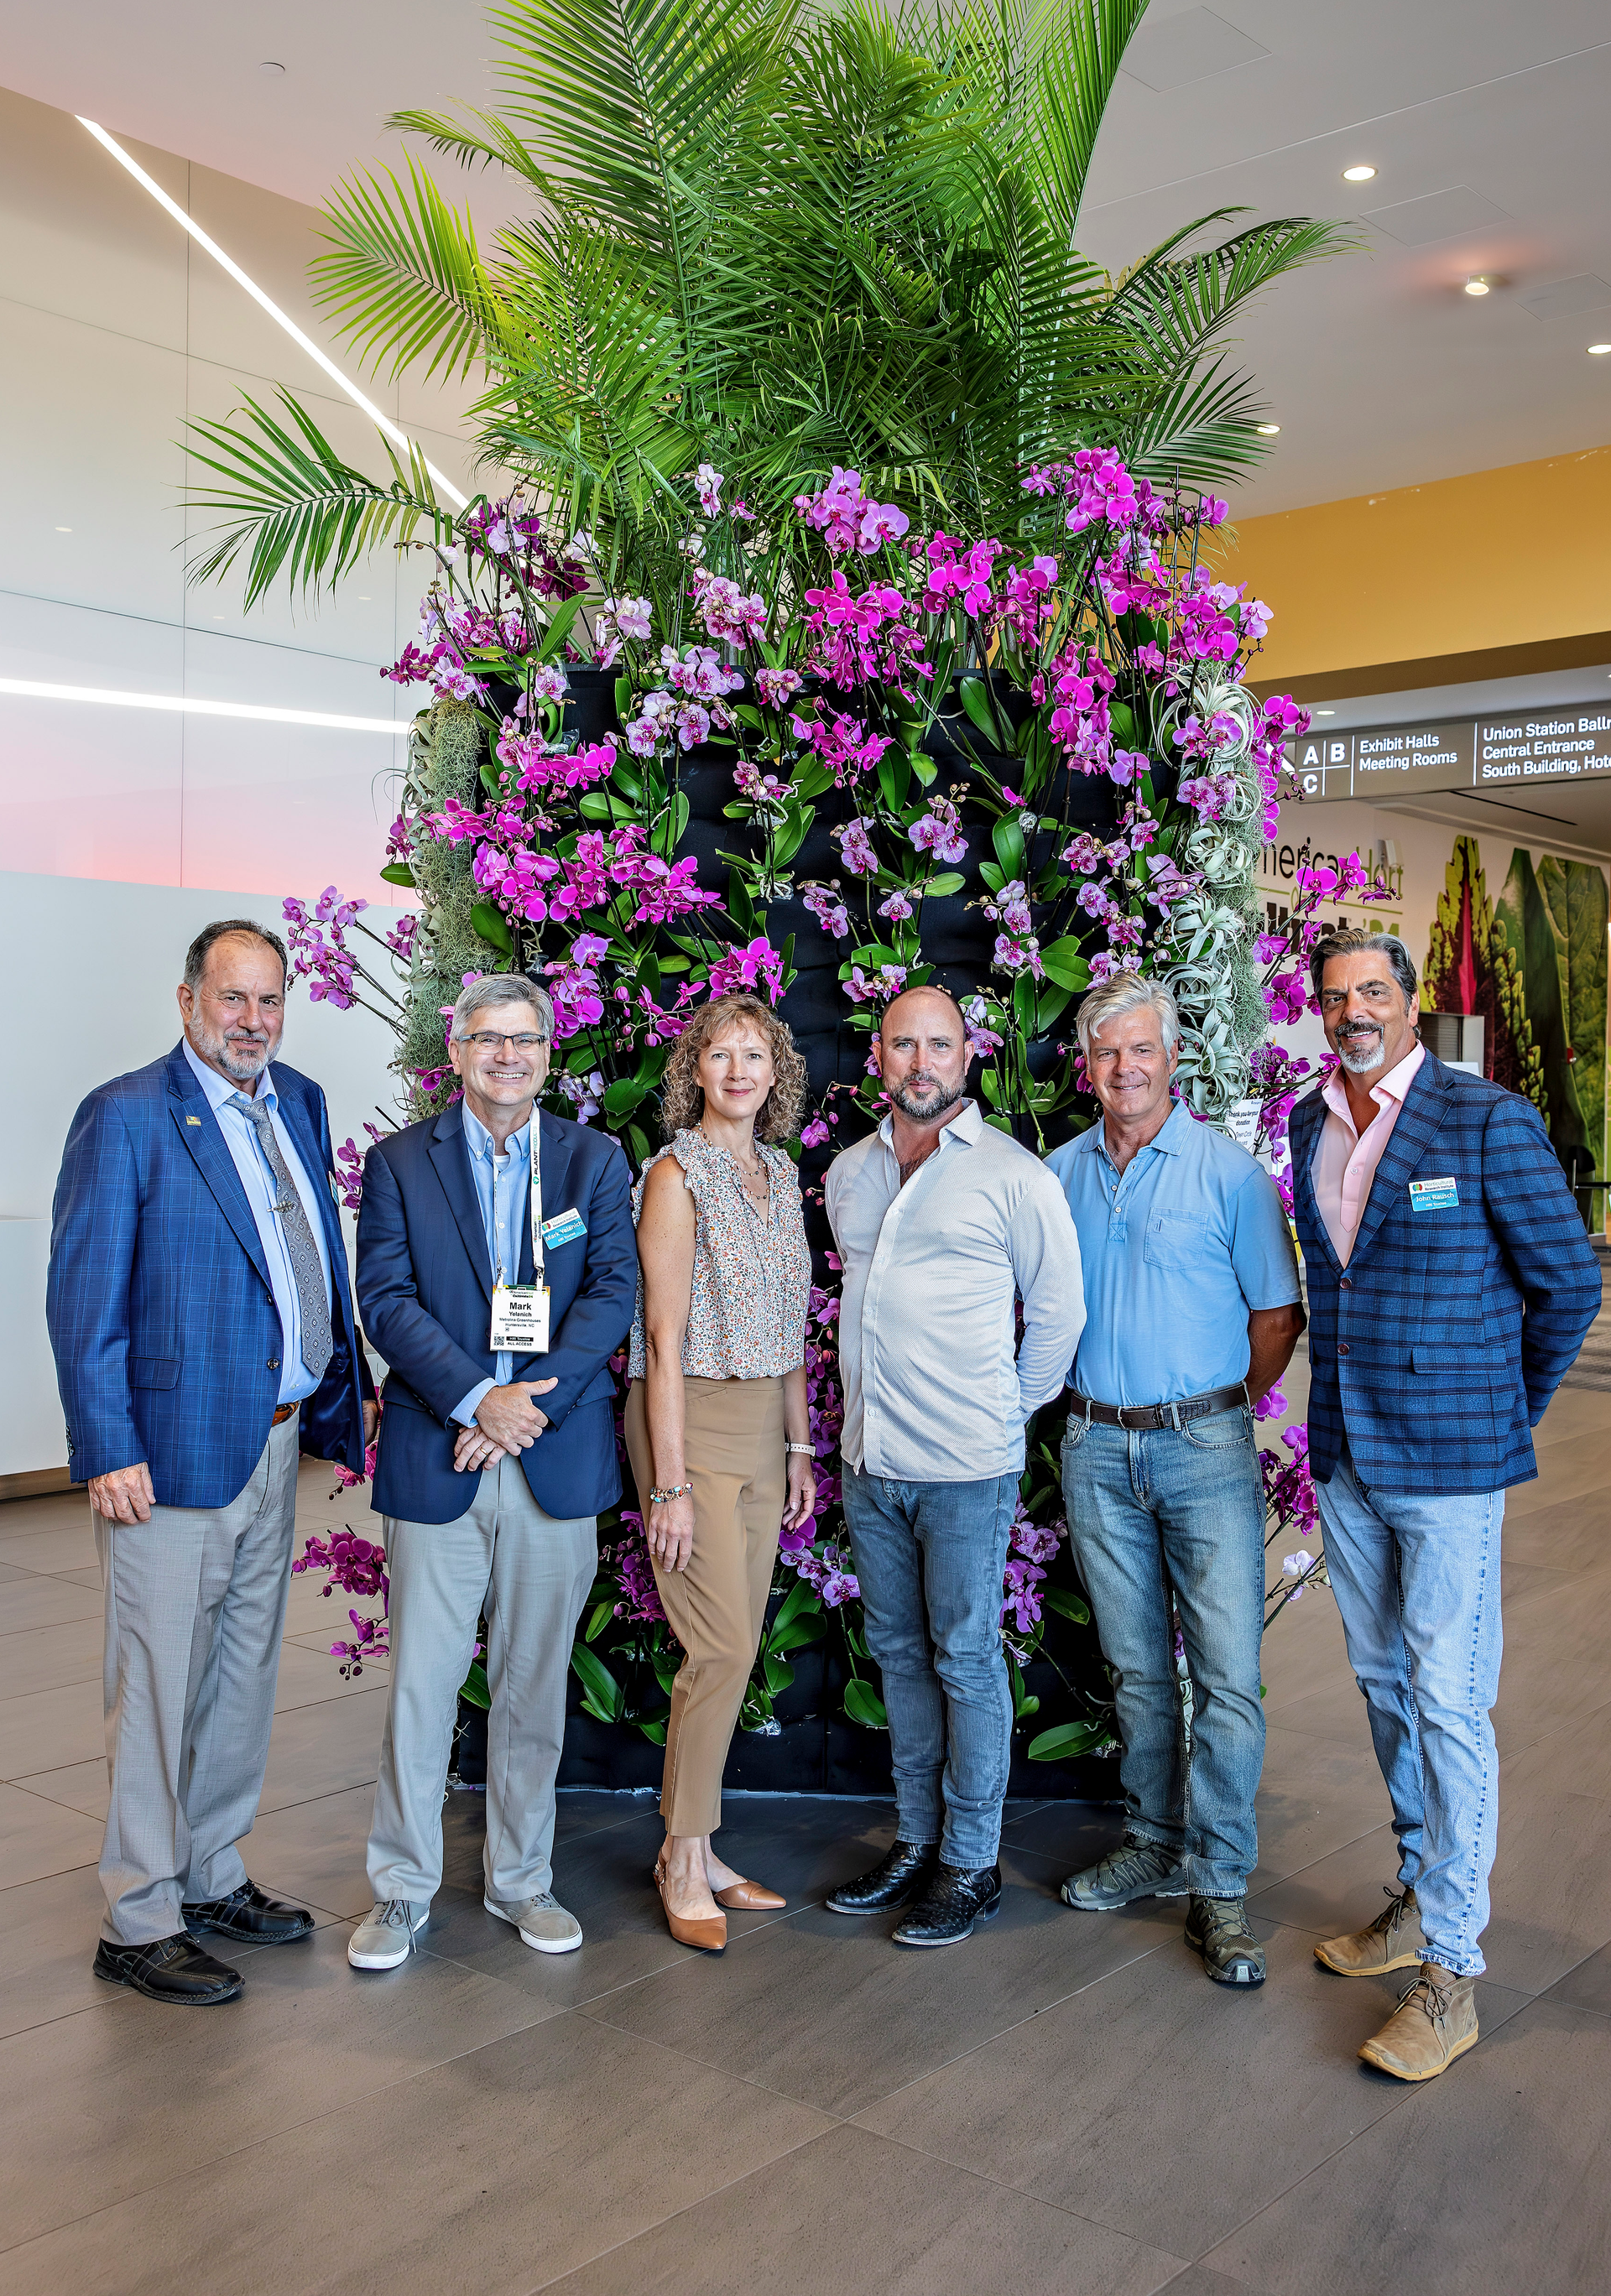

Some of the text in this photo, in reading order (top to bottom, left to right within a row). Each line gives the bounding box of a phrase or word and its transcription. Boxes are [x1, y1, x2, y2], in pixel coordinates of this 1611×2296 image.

[1483, 726, 1523, 742] Union
[1525, 721, 1575, 738] Station
[1302, 742, 1346, 766] A B
[1359, 733, 1440, 754] Exhibit Halls
[1482, 739, 1595, 760] Central Entrance
[1358, 752, 1457, 772] Meeting Rooms
[1482, 762, 1521, 778] South
[1523, 758, 1582, 775] Building,
[1302, 773, 1319, 794] C
[1431, 1191, 1455, 1200] Rausch
[545, 1221, 583, 1242] Mark Yelanich
[509, 1302, 532, 1310] Mark
